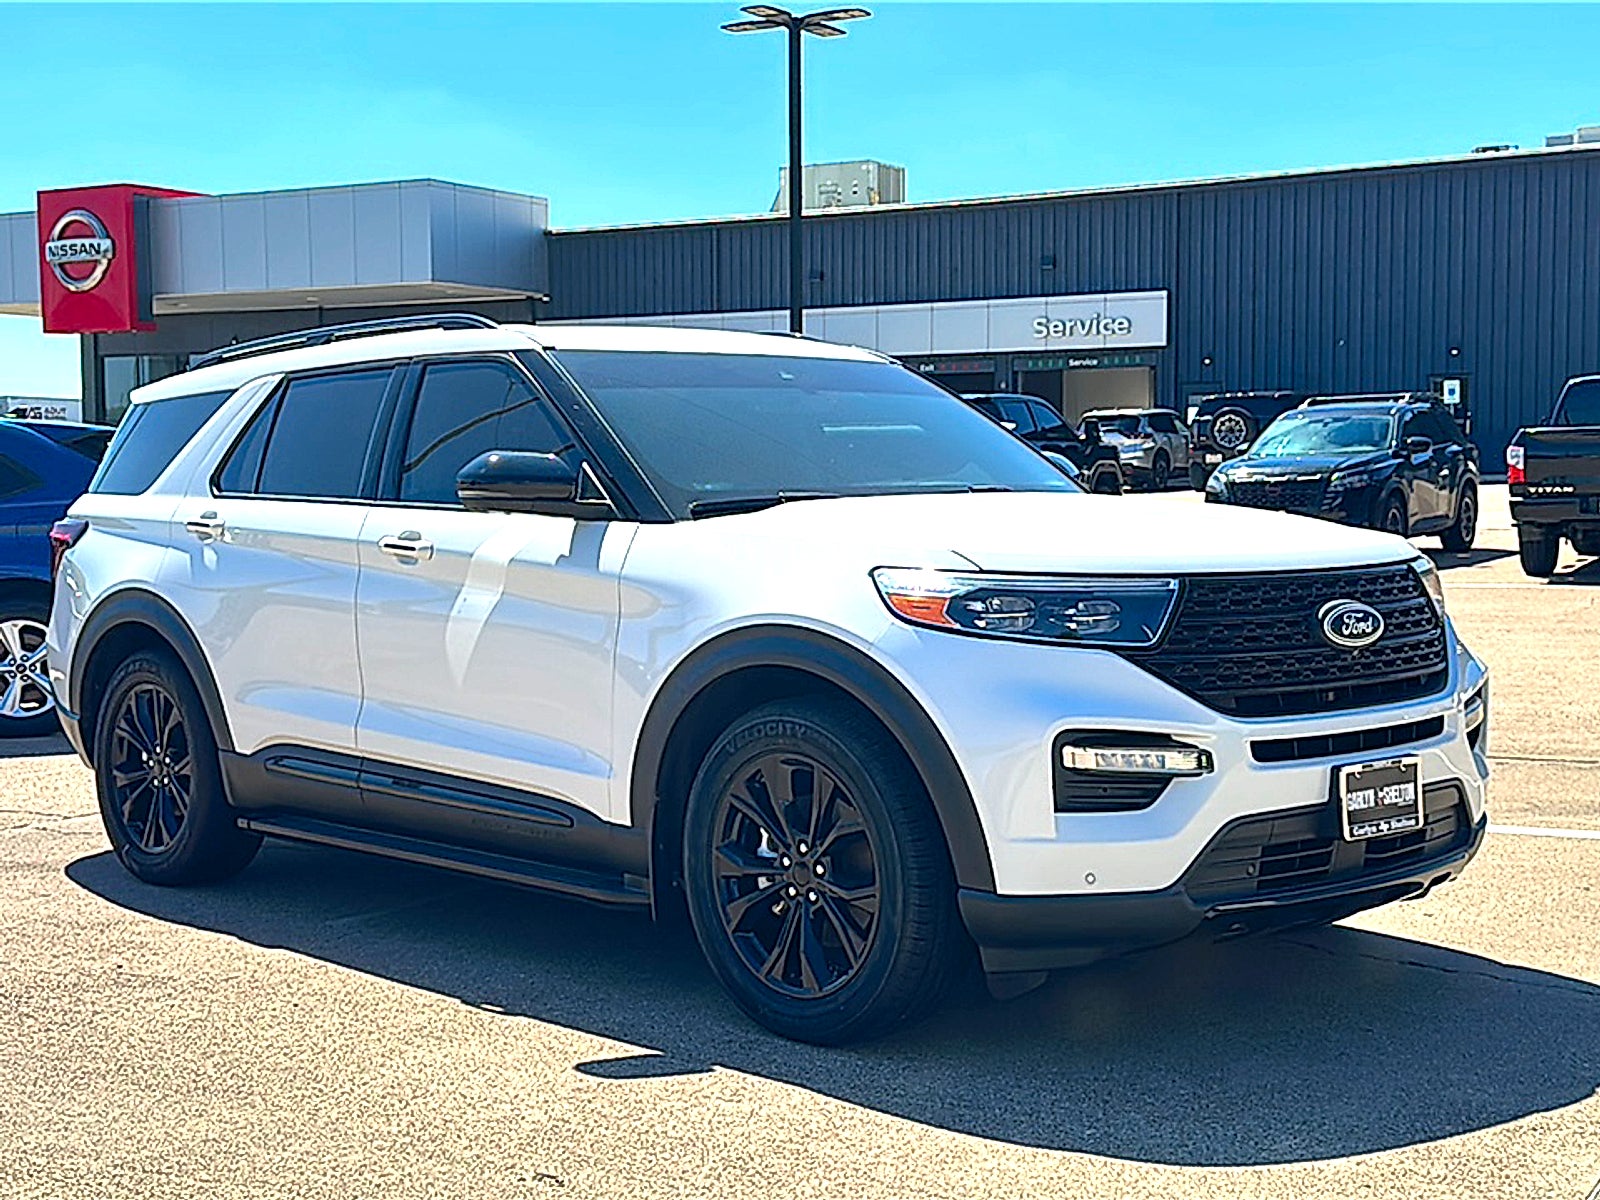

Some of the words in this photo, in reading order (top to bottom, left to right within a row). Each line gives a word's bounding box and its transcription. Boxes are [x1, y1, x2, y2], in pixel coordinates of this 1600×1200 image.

[48, 243, 101, 257] NISSAN
[1033, 312, 1132, 338] Service
[1068, 355, 1099, 367] Service
[1342, 612, 1373, 635] Ford
[725, 721, 805, 753] VELOCITY
